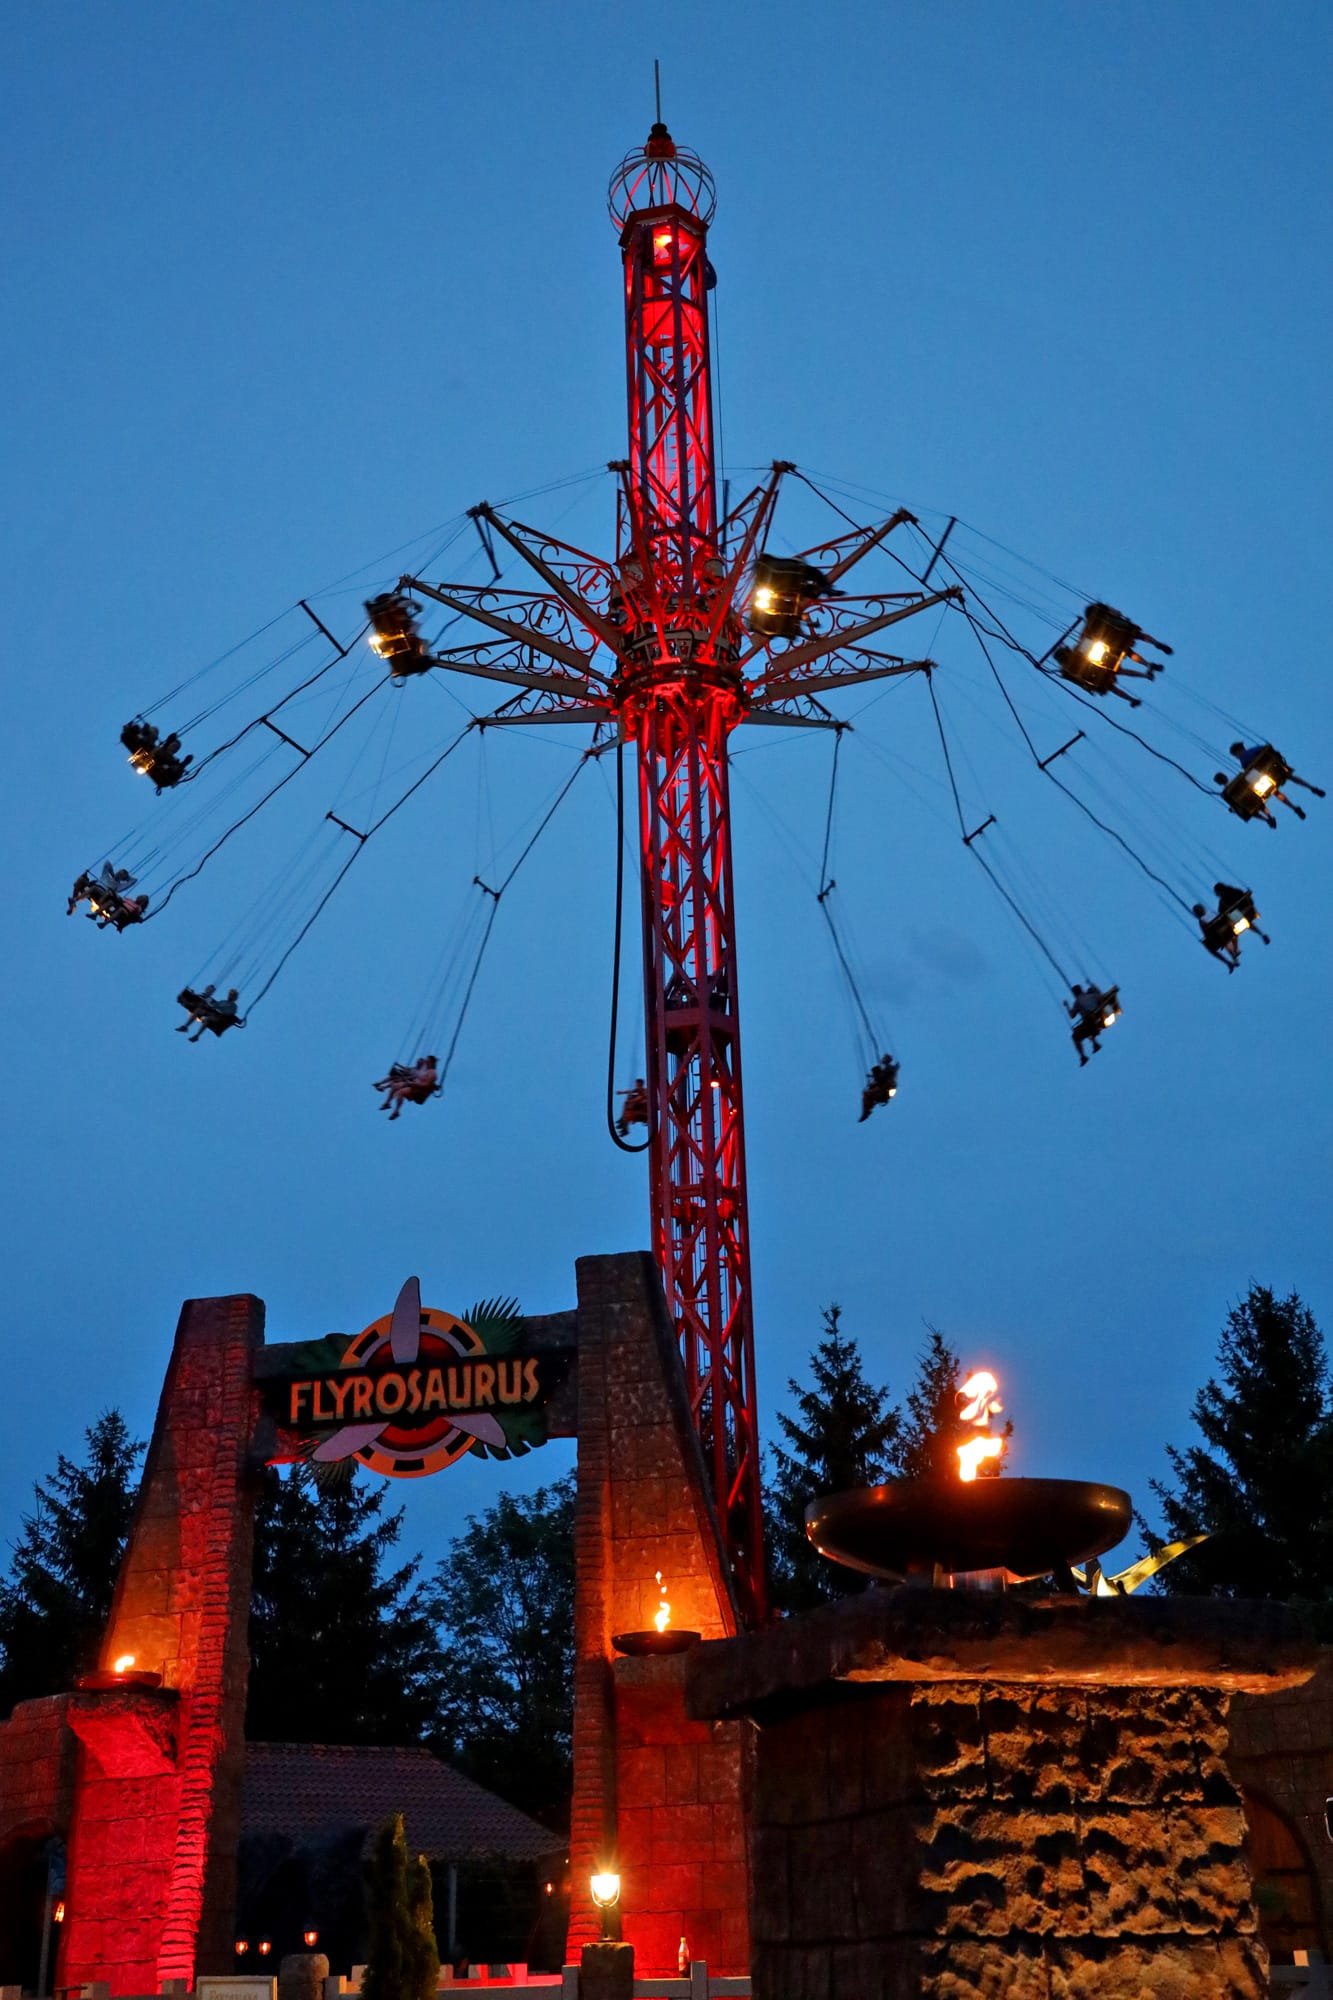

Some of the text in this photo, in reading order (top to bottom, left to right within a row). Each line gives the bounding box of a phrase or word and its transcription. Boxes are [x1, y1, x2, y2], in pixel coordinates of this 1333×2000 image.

[580, 568, 611, 596] F
[533, 600, 563, 630] F
[290, 1358, 539, 1423] FLYROSAURUS
